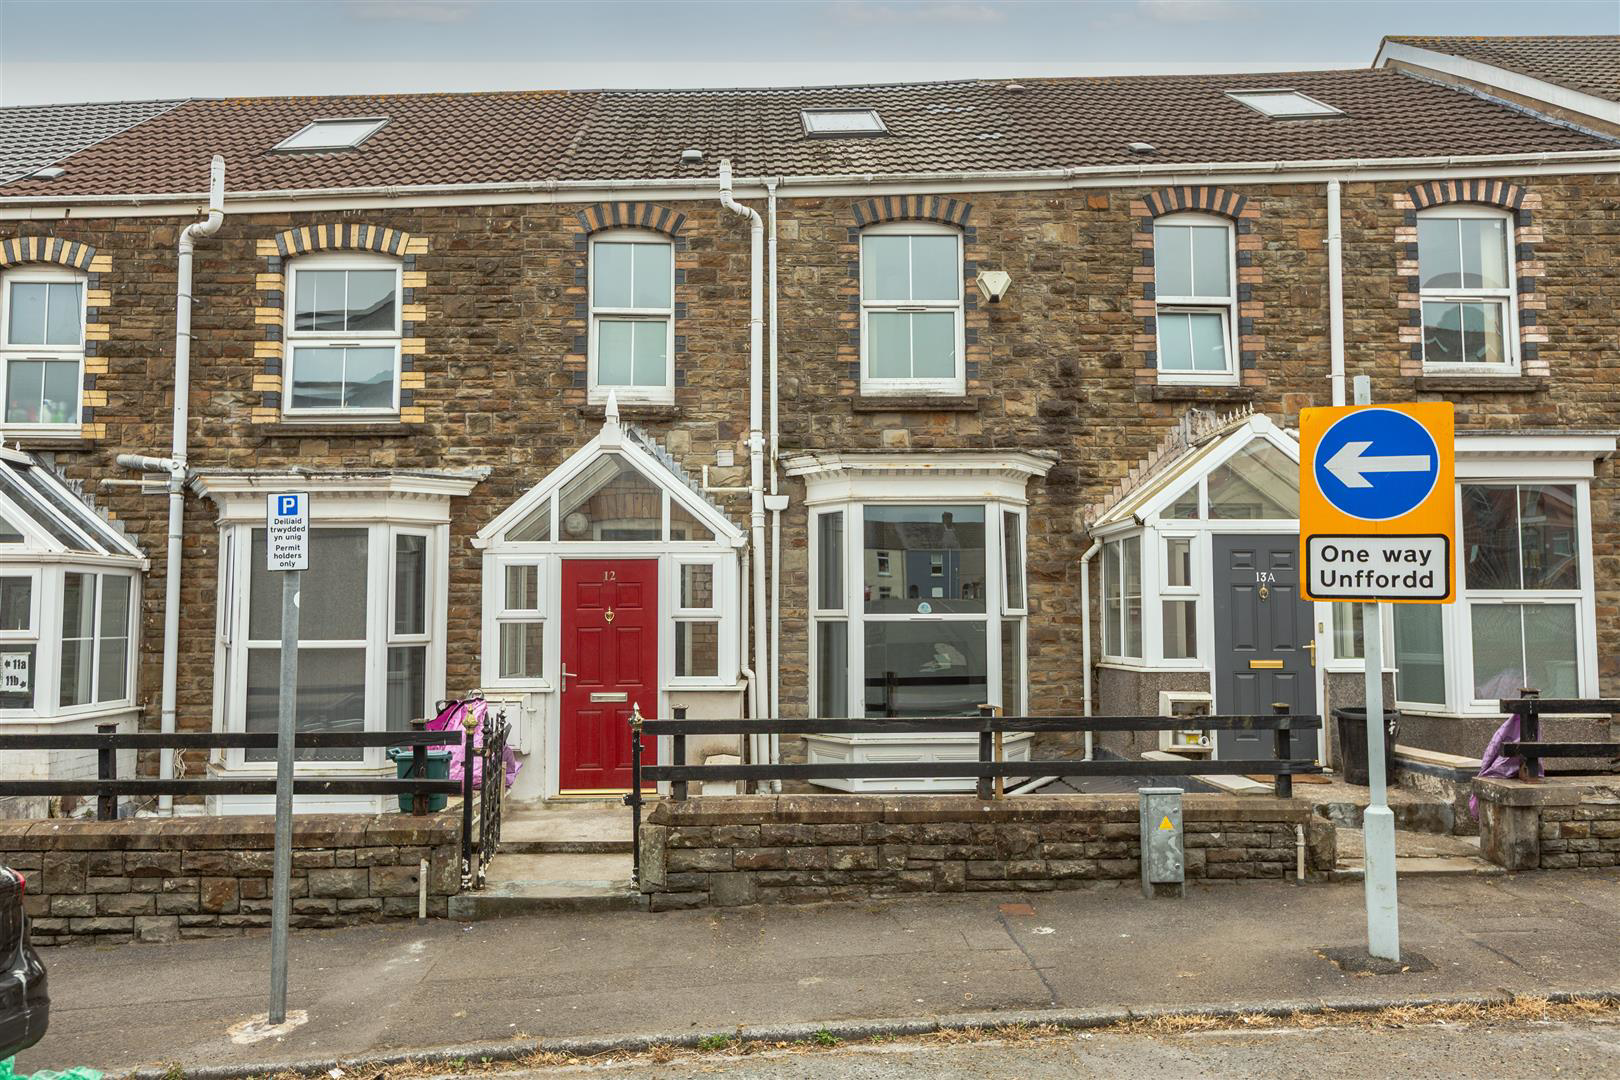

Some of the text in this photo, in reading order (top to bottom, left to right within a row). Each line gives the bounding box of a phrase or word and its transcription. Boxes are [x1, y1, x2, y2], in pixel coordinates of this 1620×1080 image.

[282, 497, 295, 514] P
[270, 526, 306, 534] trwydded
[1321, 545, 1432, 566] One way
[604, 570, 616, 581] 12
[1256, 571, 1276, 583] 13A
[1320, 570, 1434, 588] Unffordd
[12, 659, 27, 670] 11a
[5, 675, 19, 686] 11b
